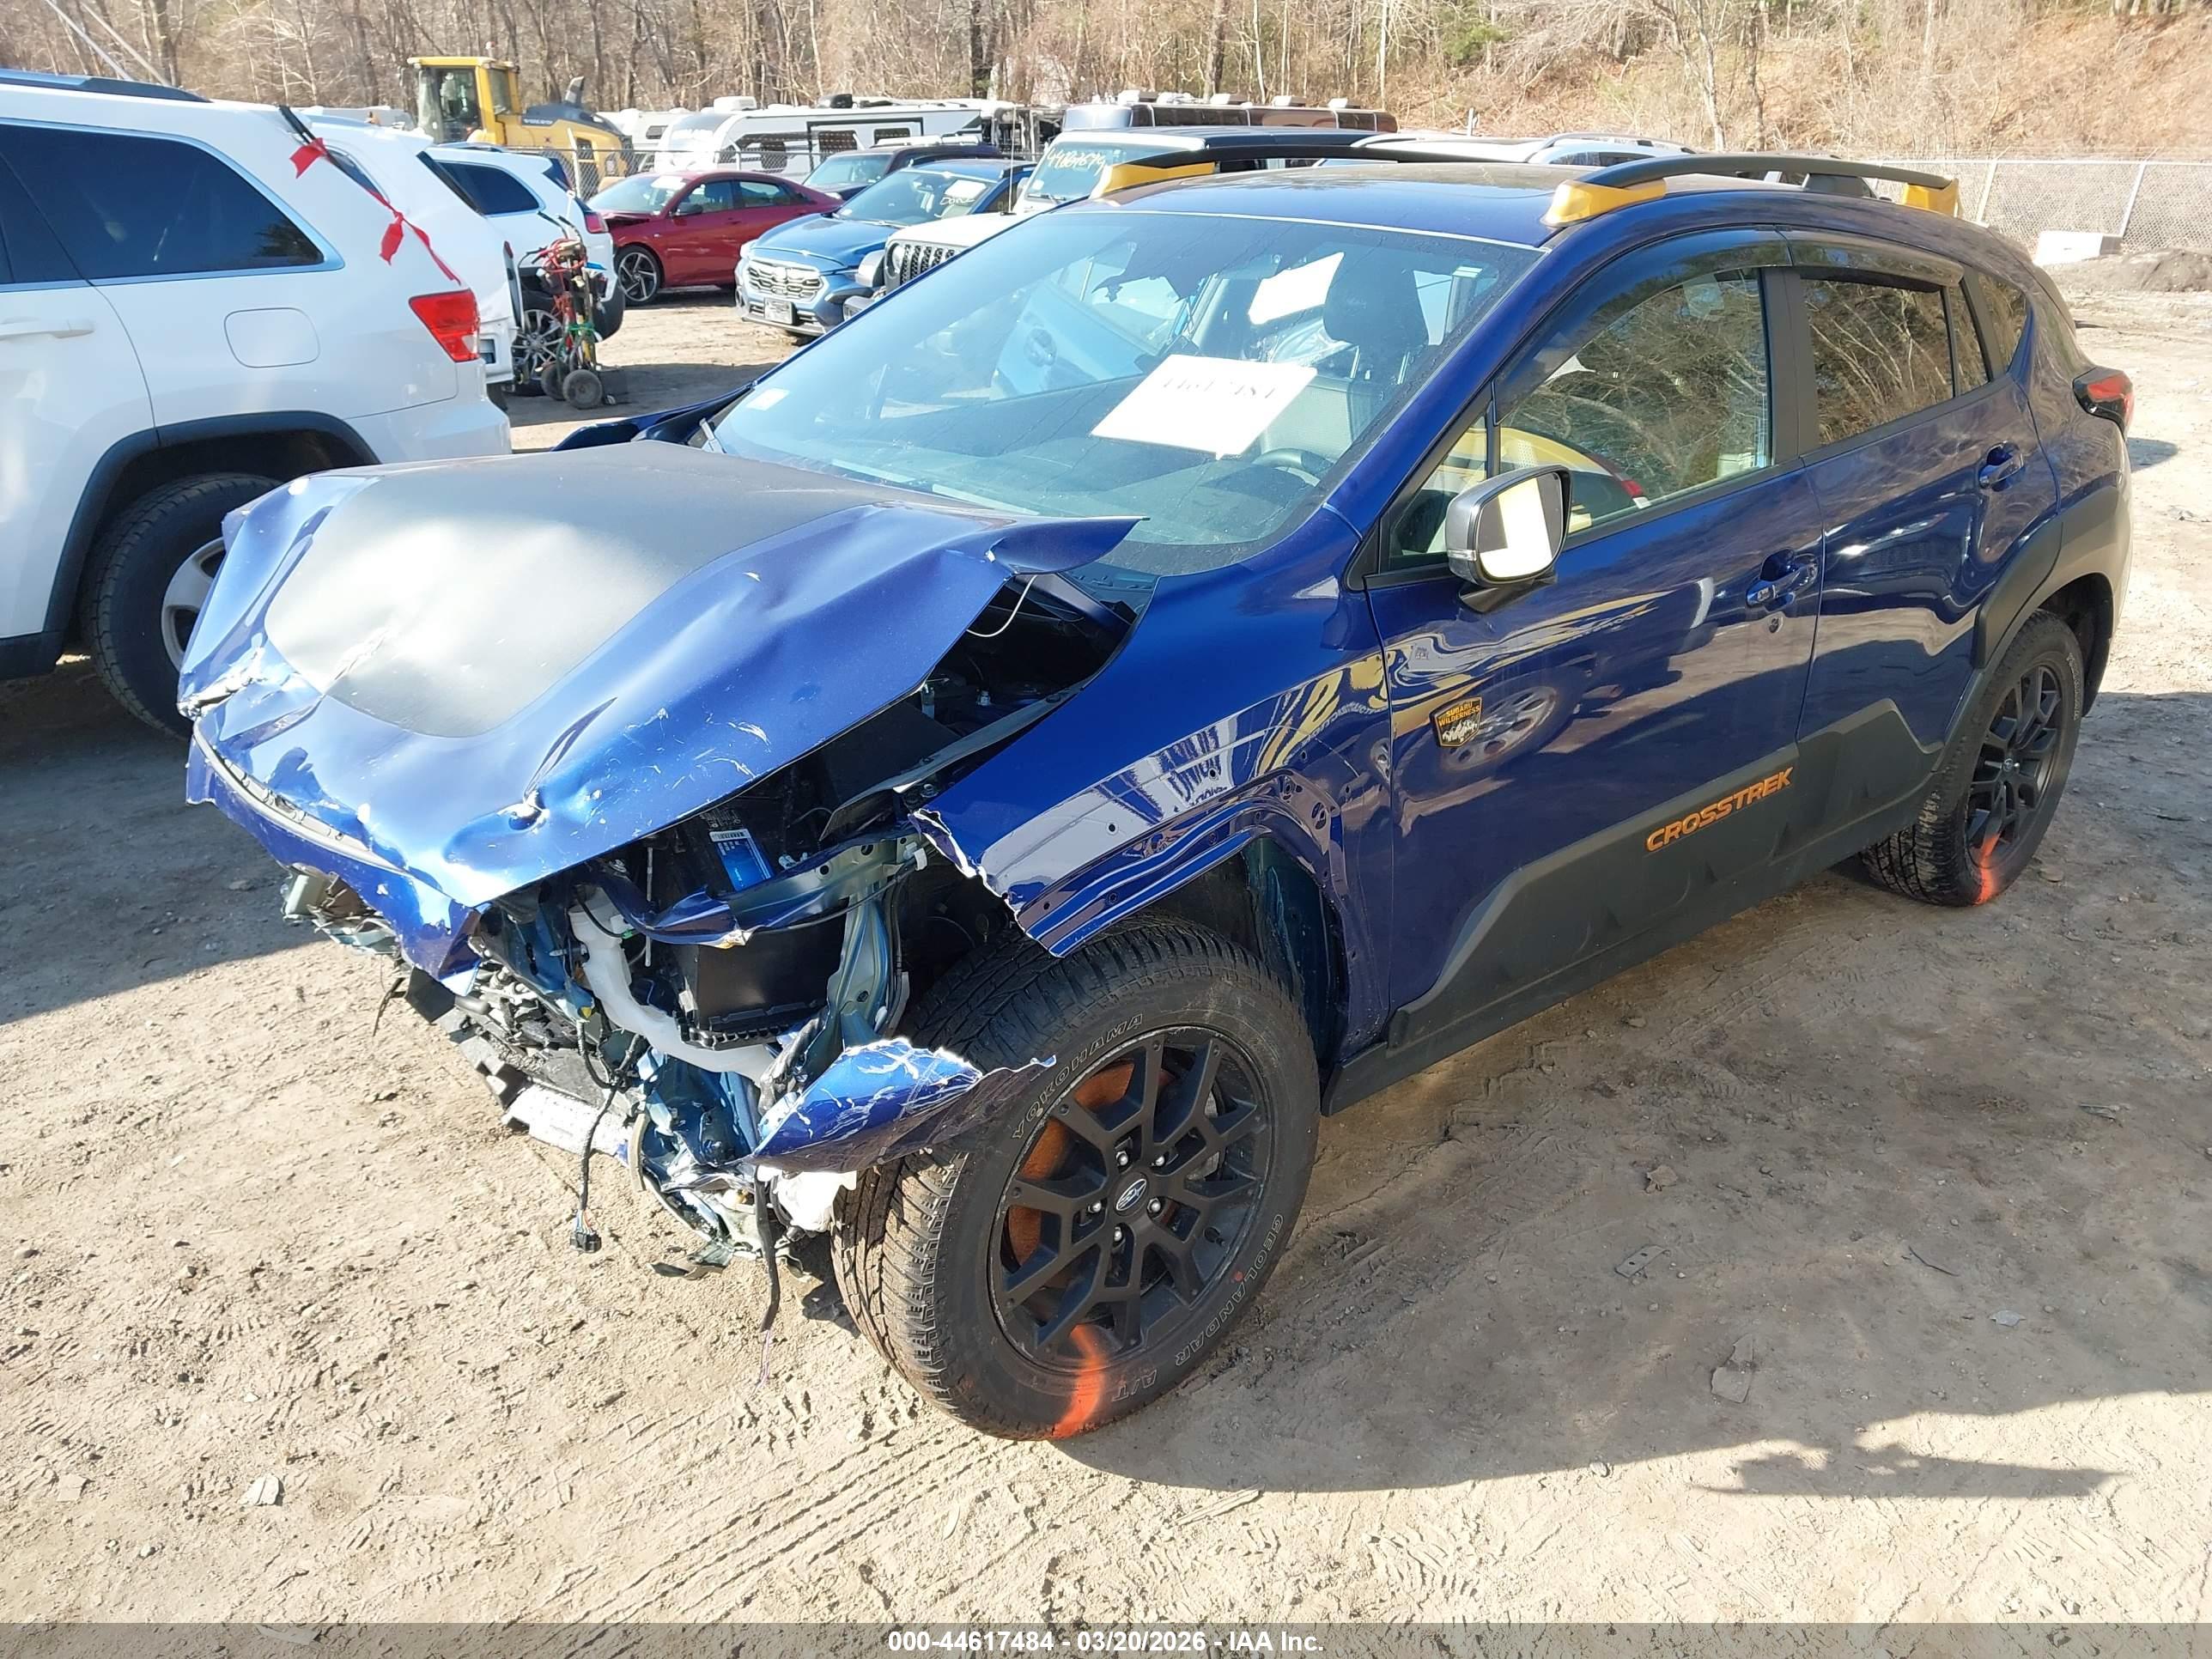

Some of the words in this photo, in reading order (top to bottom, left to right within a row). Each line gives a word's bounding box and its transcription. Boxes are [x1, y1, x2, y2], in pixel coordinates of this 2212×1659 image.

[1438, 704, 1480, 727] WILDERNESS
[1446, 700, 1474, 716] SUBARU
[1646, 766, 1794, 852] CROSSTREK
[1012, 1013, 1143, 1139] YOKOHAMA
[1175, 1213, 1285, 1366] GEOLANDAR
[1111, 1369, 1158, 1402] A/T
